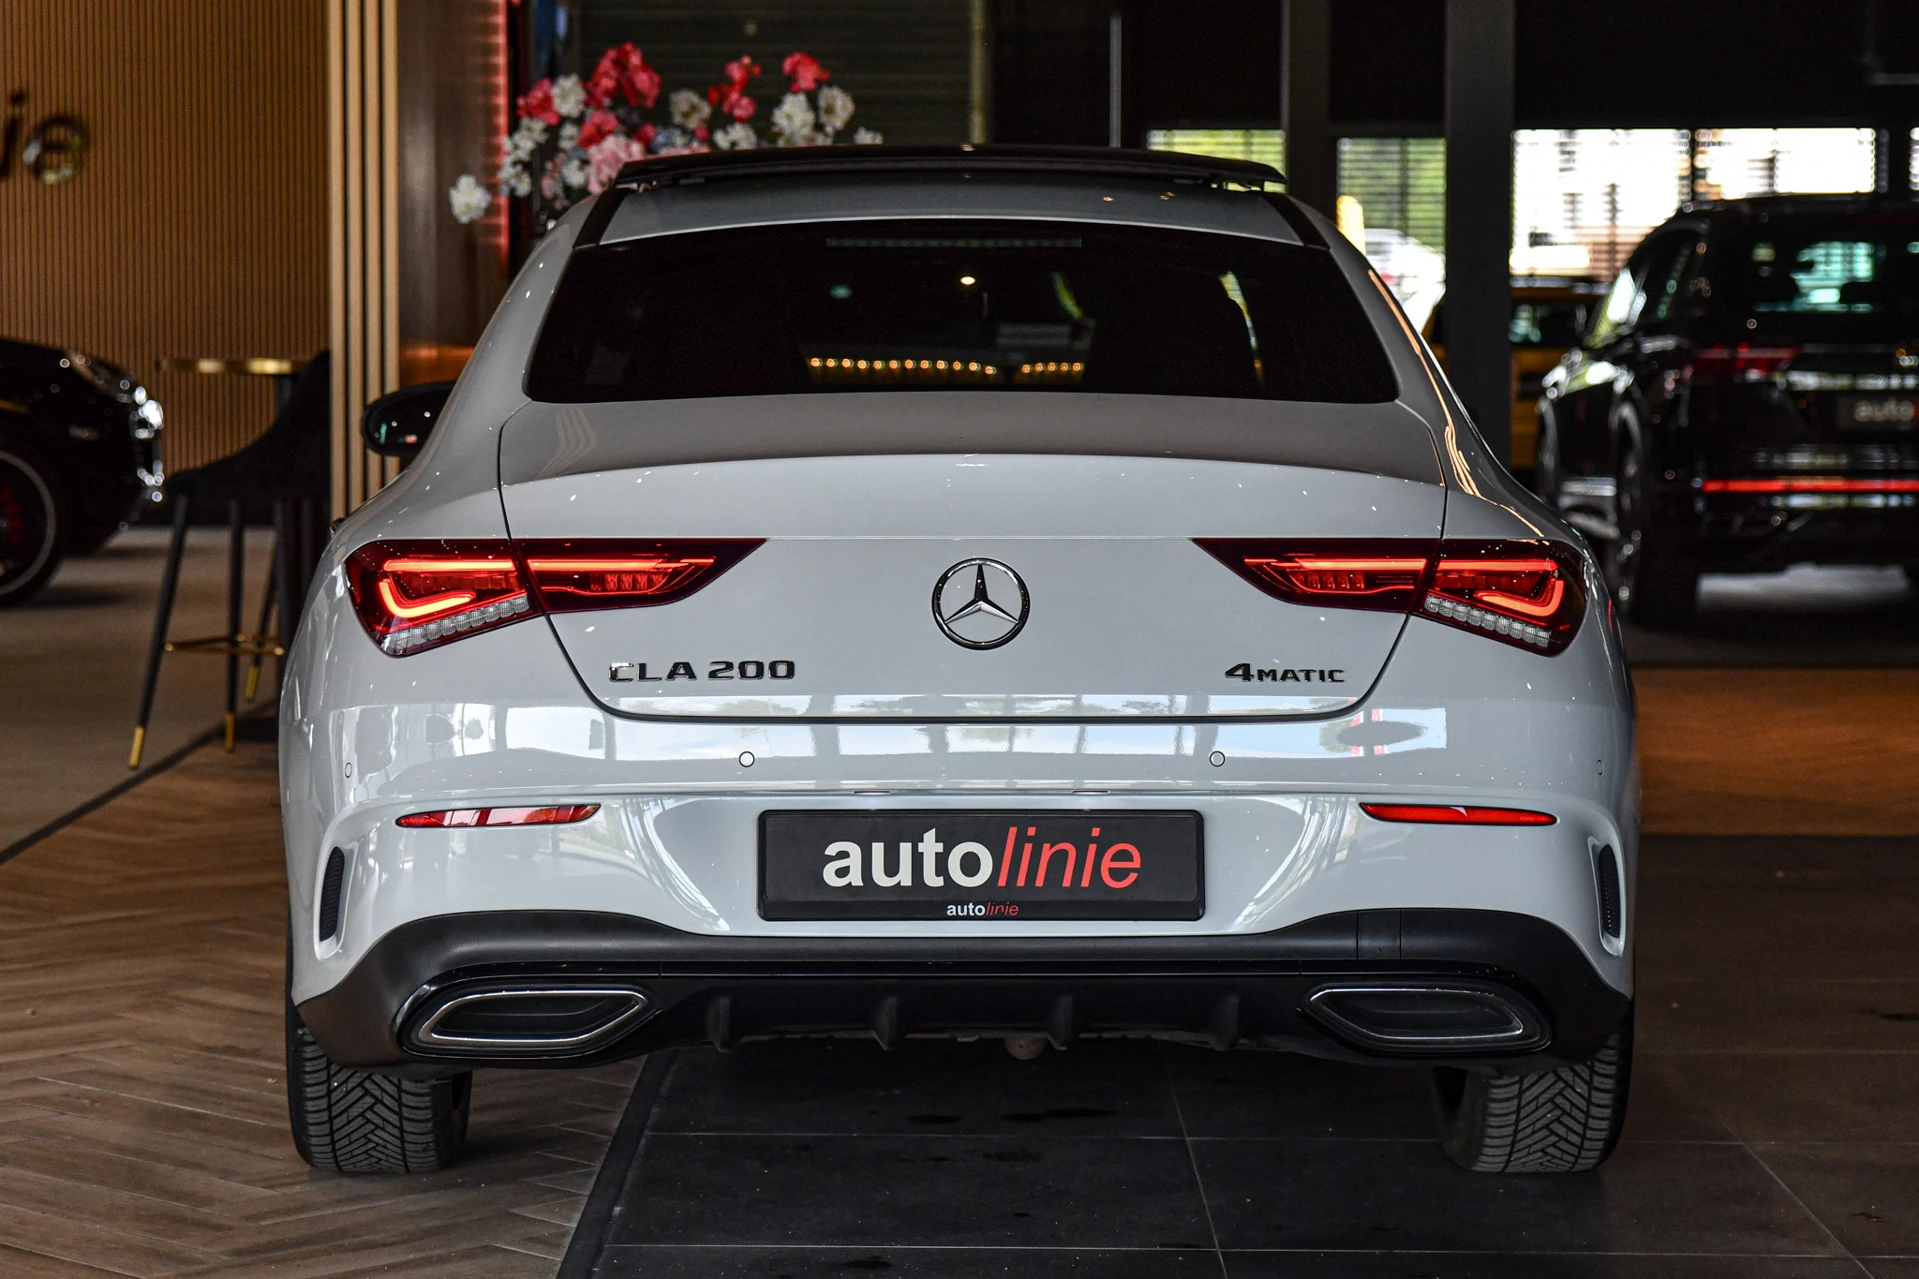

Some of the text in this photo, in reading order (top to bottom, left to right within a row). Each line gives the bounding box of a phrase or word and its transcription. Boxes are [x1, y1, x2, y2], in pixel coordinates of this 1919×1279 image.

[1855, 397, 1919, 421] auto
[609, 660, 796, 682] CLA 200
[1225, 663, 1345, 682] 4MATIC
[822, 826, 1141, 888] autolinie
[946, 901, 1019, 916] autolinie
